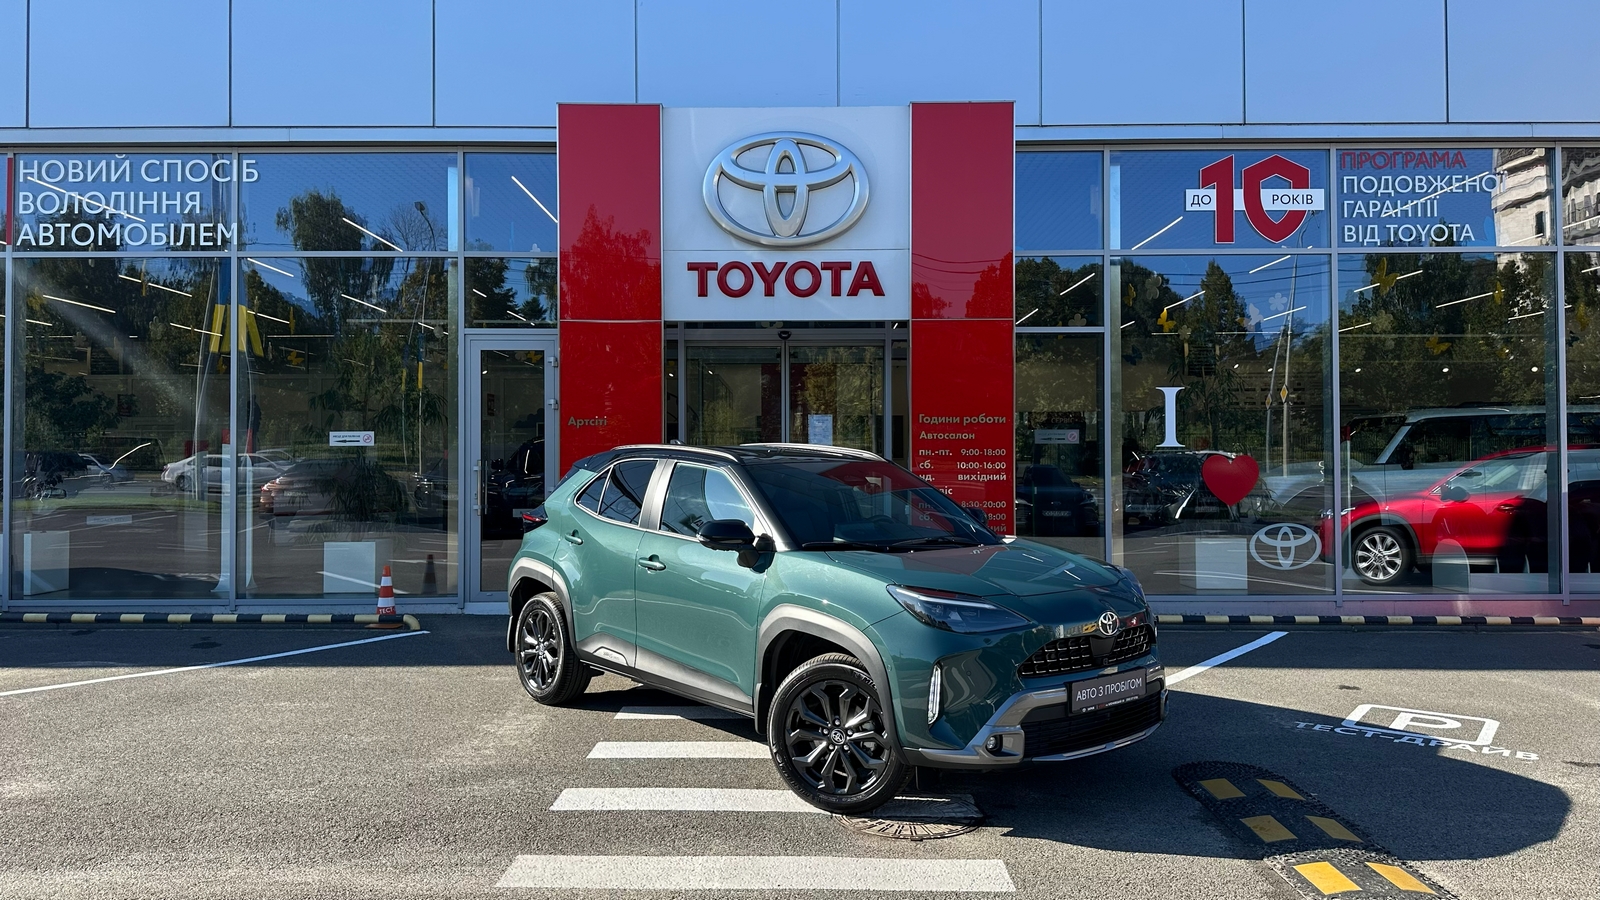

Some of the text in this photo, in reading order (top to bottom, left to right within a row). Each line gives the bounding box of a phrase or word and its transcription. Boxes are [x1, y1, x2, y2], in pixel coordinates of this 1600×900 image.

[19, 154, 259, 183] НОВИЙ СПОСІБ
[1341, 151, 1467, 170] ПРОГРАМА
[1343, 171, 1508, 197] ПОДОВЖЕНОЇ
[19, 191, 201, 219] ВОЛОДІННЯ
[1191, 154, 1314, 243] ДО 10 РОКІВ
[1343, 195, 1440, 218] ГАРАНТІЇ
[16, 222, 238, 246] АВТОМОБІЛЕМ
[1344, 223, 1475, 245] ВІД TOYOTA
[687, 260, 885, 298] TOYOTA
[567, 415, 607, 429] Артсіті
[918, 413, 1006, 426] Години роботи
[919, 430, 975, 440] Автосалон
[960, 448, 1006, 456] 9:00-18:00
[918, 460, 1006, 469] сб. 10:00-16:00
[957, 471, 1006, 482] вихідний
[960, 500, 1006, 508] 8:30-20:00
[1076, 677, 1142, 702] АВТО З ПРОБІГОМ
[1294, 721, 1540, 761] ТЕСТ-ДРАЙВ
